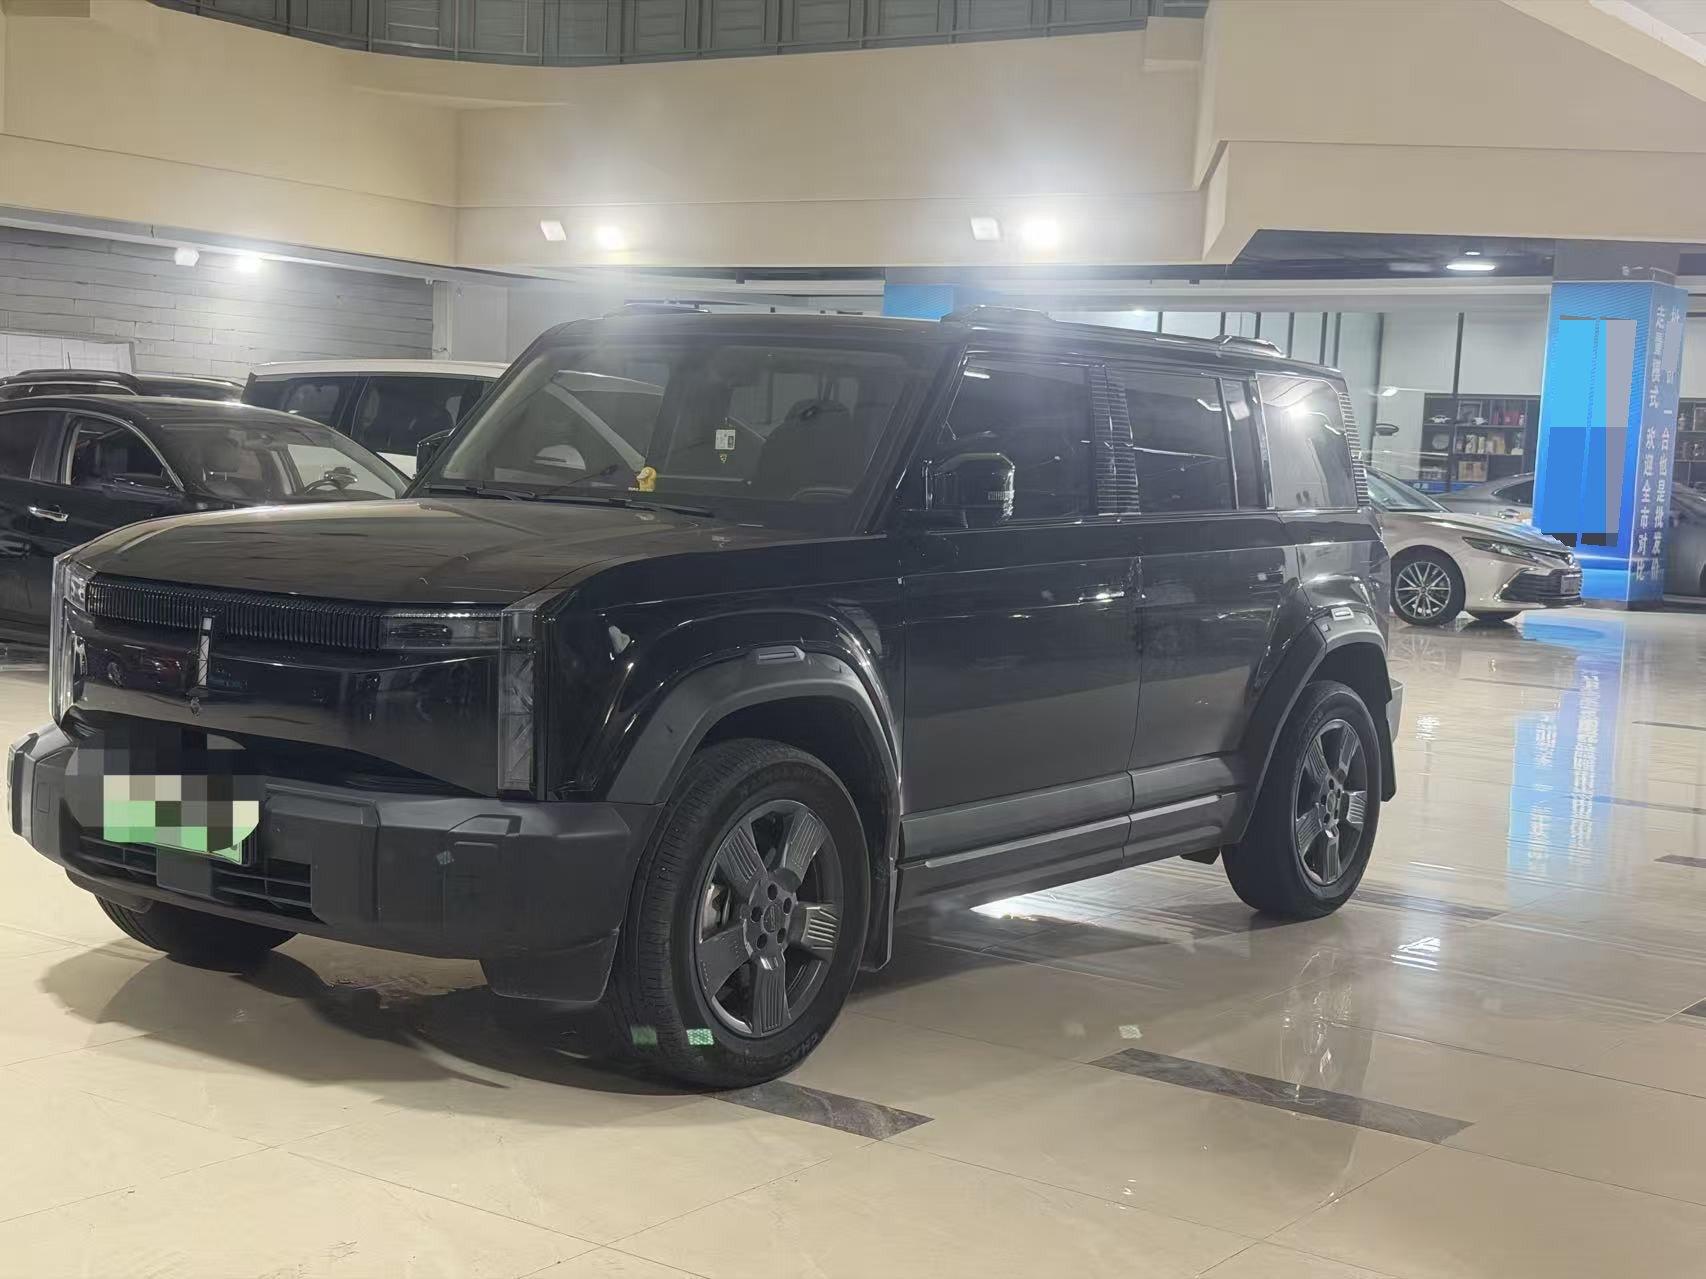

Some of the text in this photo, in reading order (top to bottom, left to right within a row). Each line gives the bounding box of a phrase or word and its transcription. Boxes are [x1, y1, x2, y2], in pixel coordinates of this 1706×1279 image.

[1635, 426, 1656, 581] 欢迎全市对比
